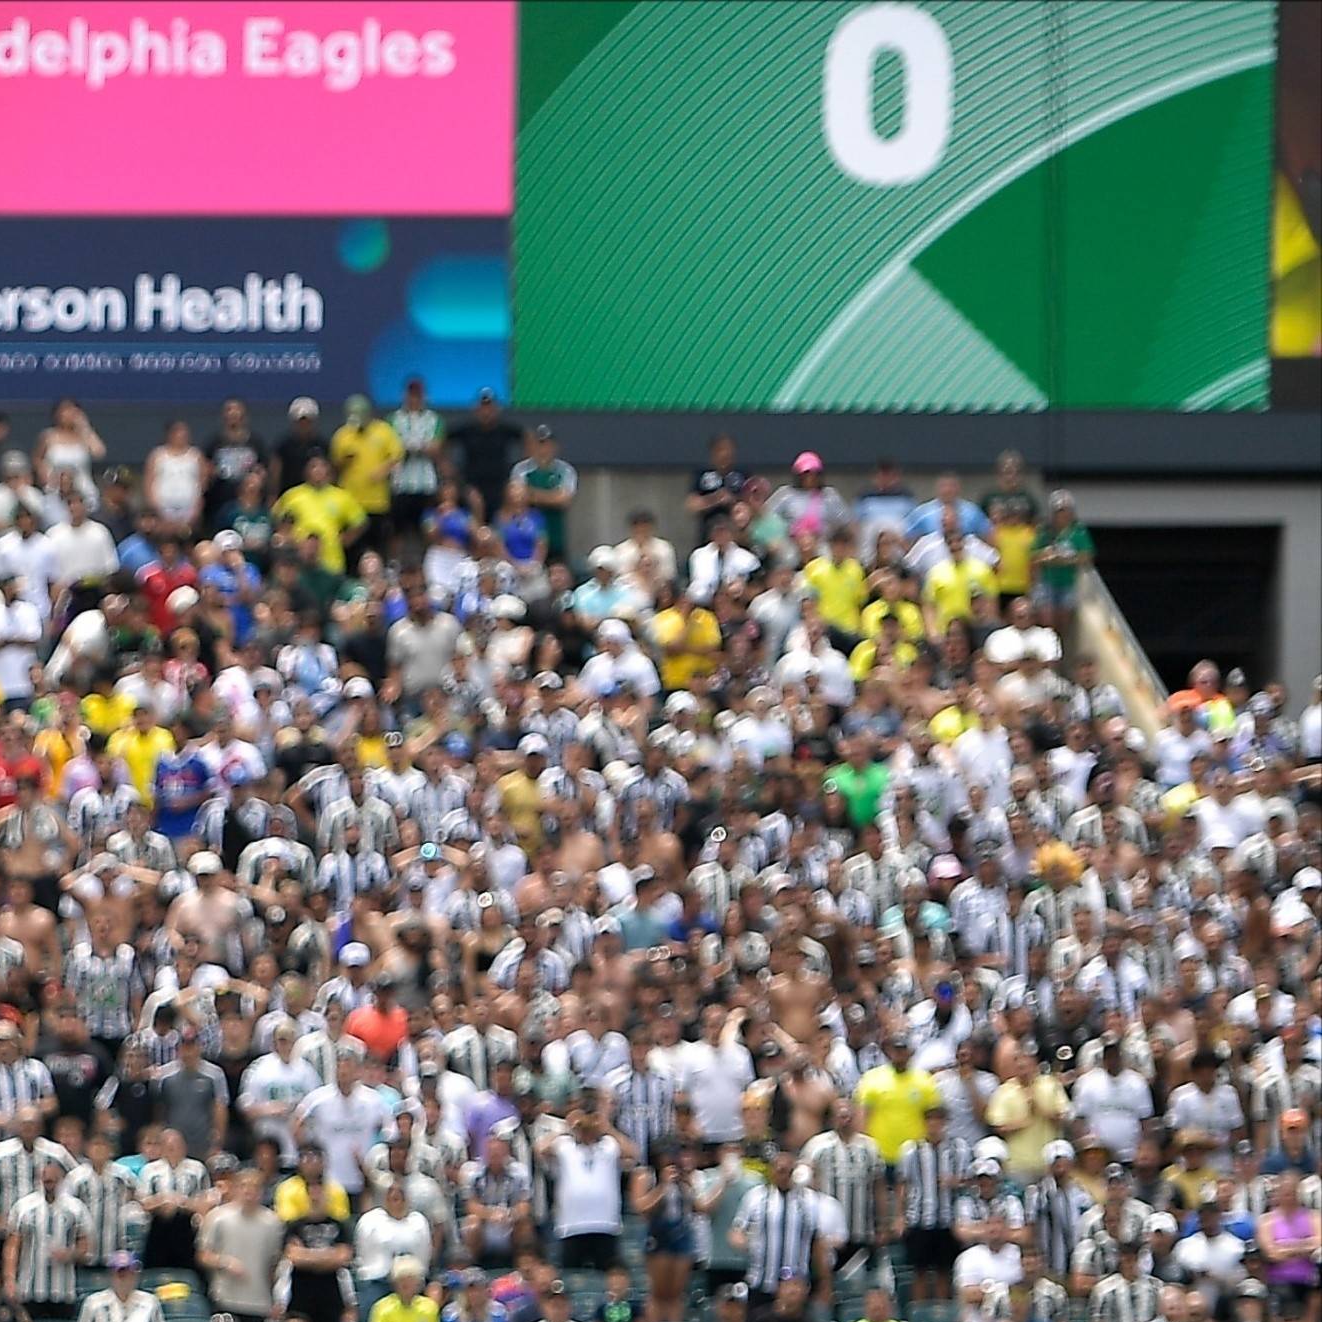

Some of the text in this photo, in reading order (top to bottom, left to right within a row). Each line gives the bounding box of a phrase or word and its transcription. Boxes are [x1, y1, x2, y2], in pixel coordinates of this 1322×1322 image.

[242, 16, 456, 92] Eagles
[821, 3, 953, 186] 0
[134, 271, 323, 333] Health
